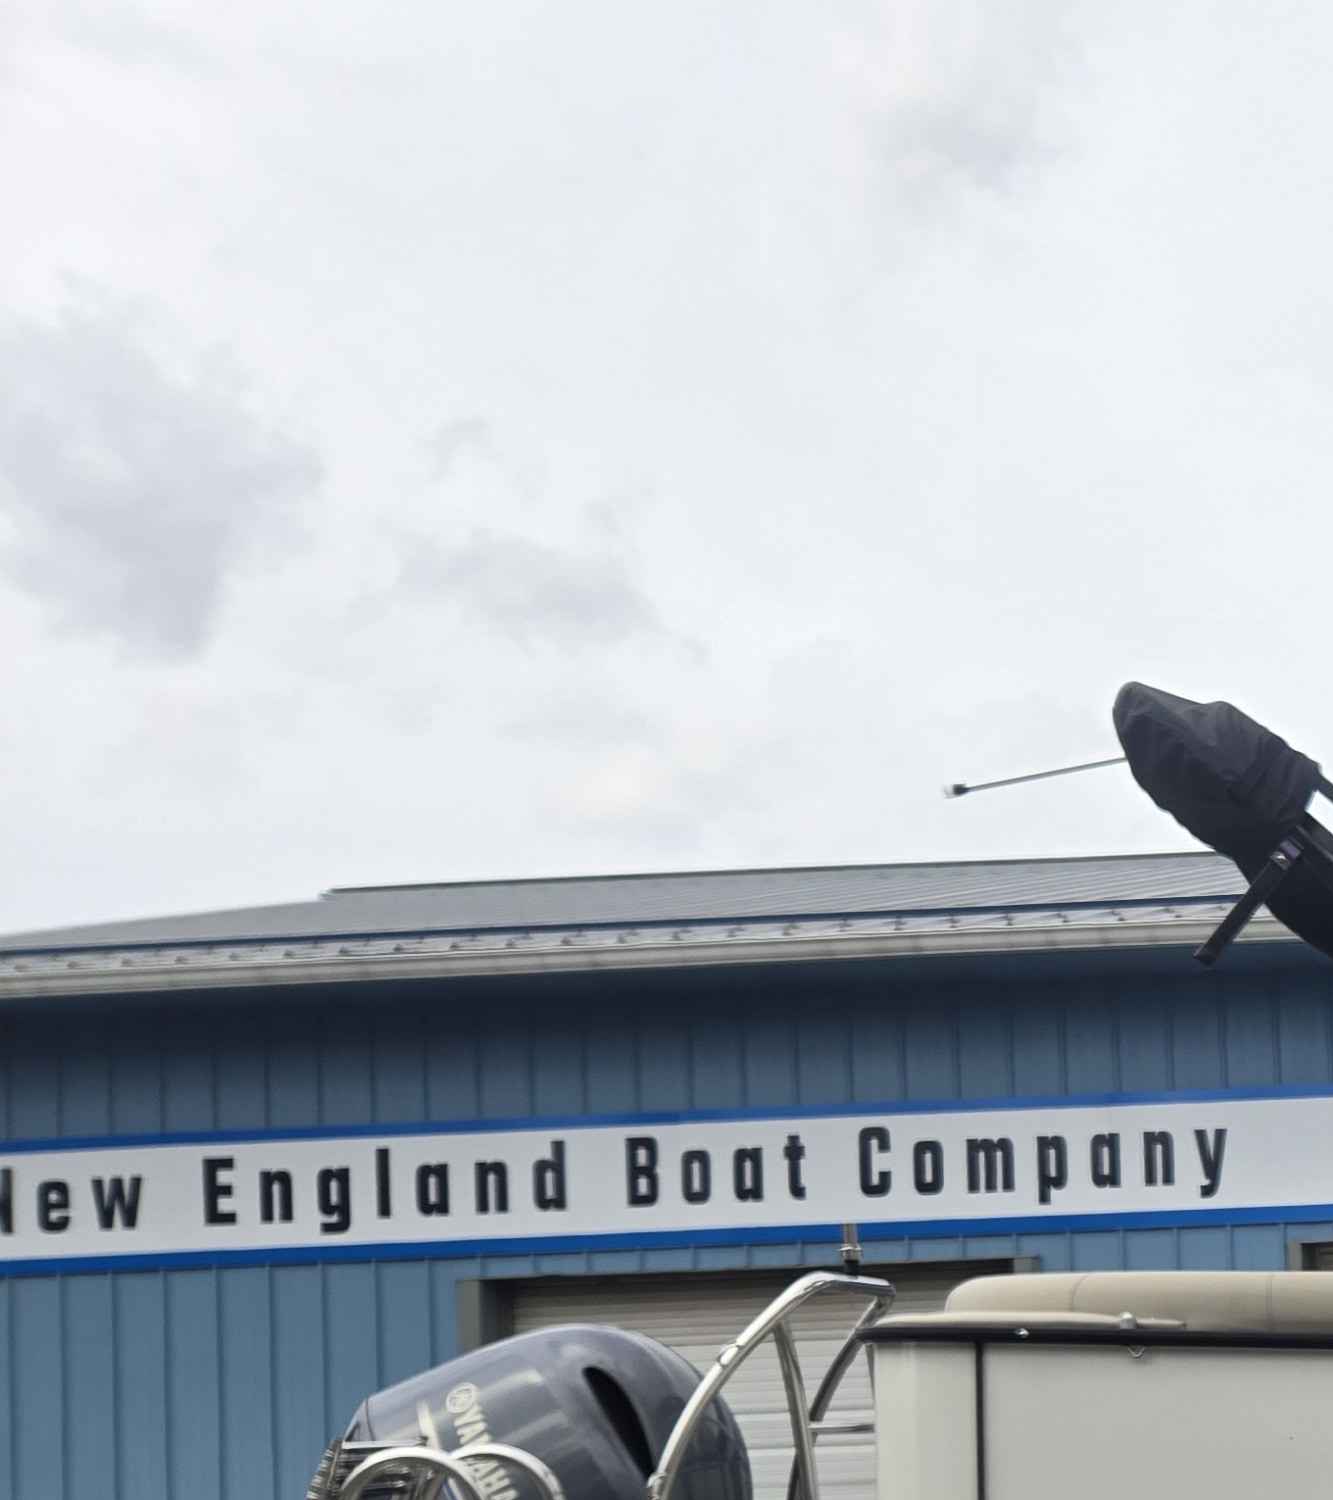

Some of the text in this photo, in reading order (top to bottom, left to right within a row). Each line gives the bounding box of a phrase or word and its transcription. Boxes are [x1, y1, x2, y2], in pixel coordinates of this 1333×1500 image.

[201, 1138, 568, 1234] England
[625, 1134, 806, 1207] Boat
[857, 1125, 1227, 1205] Company
